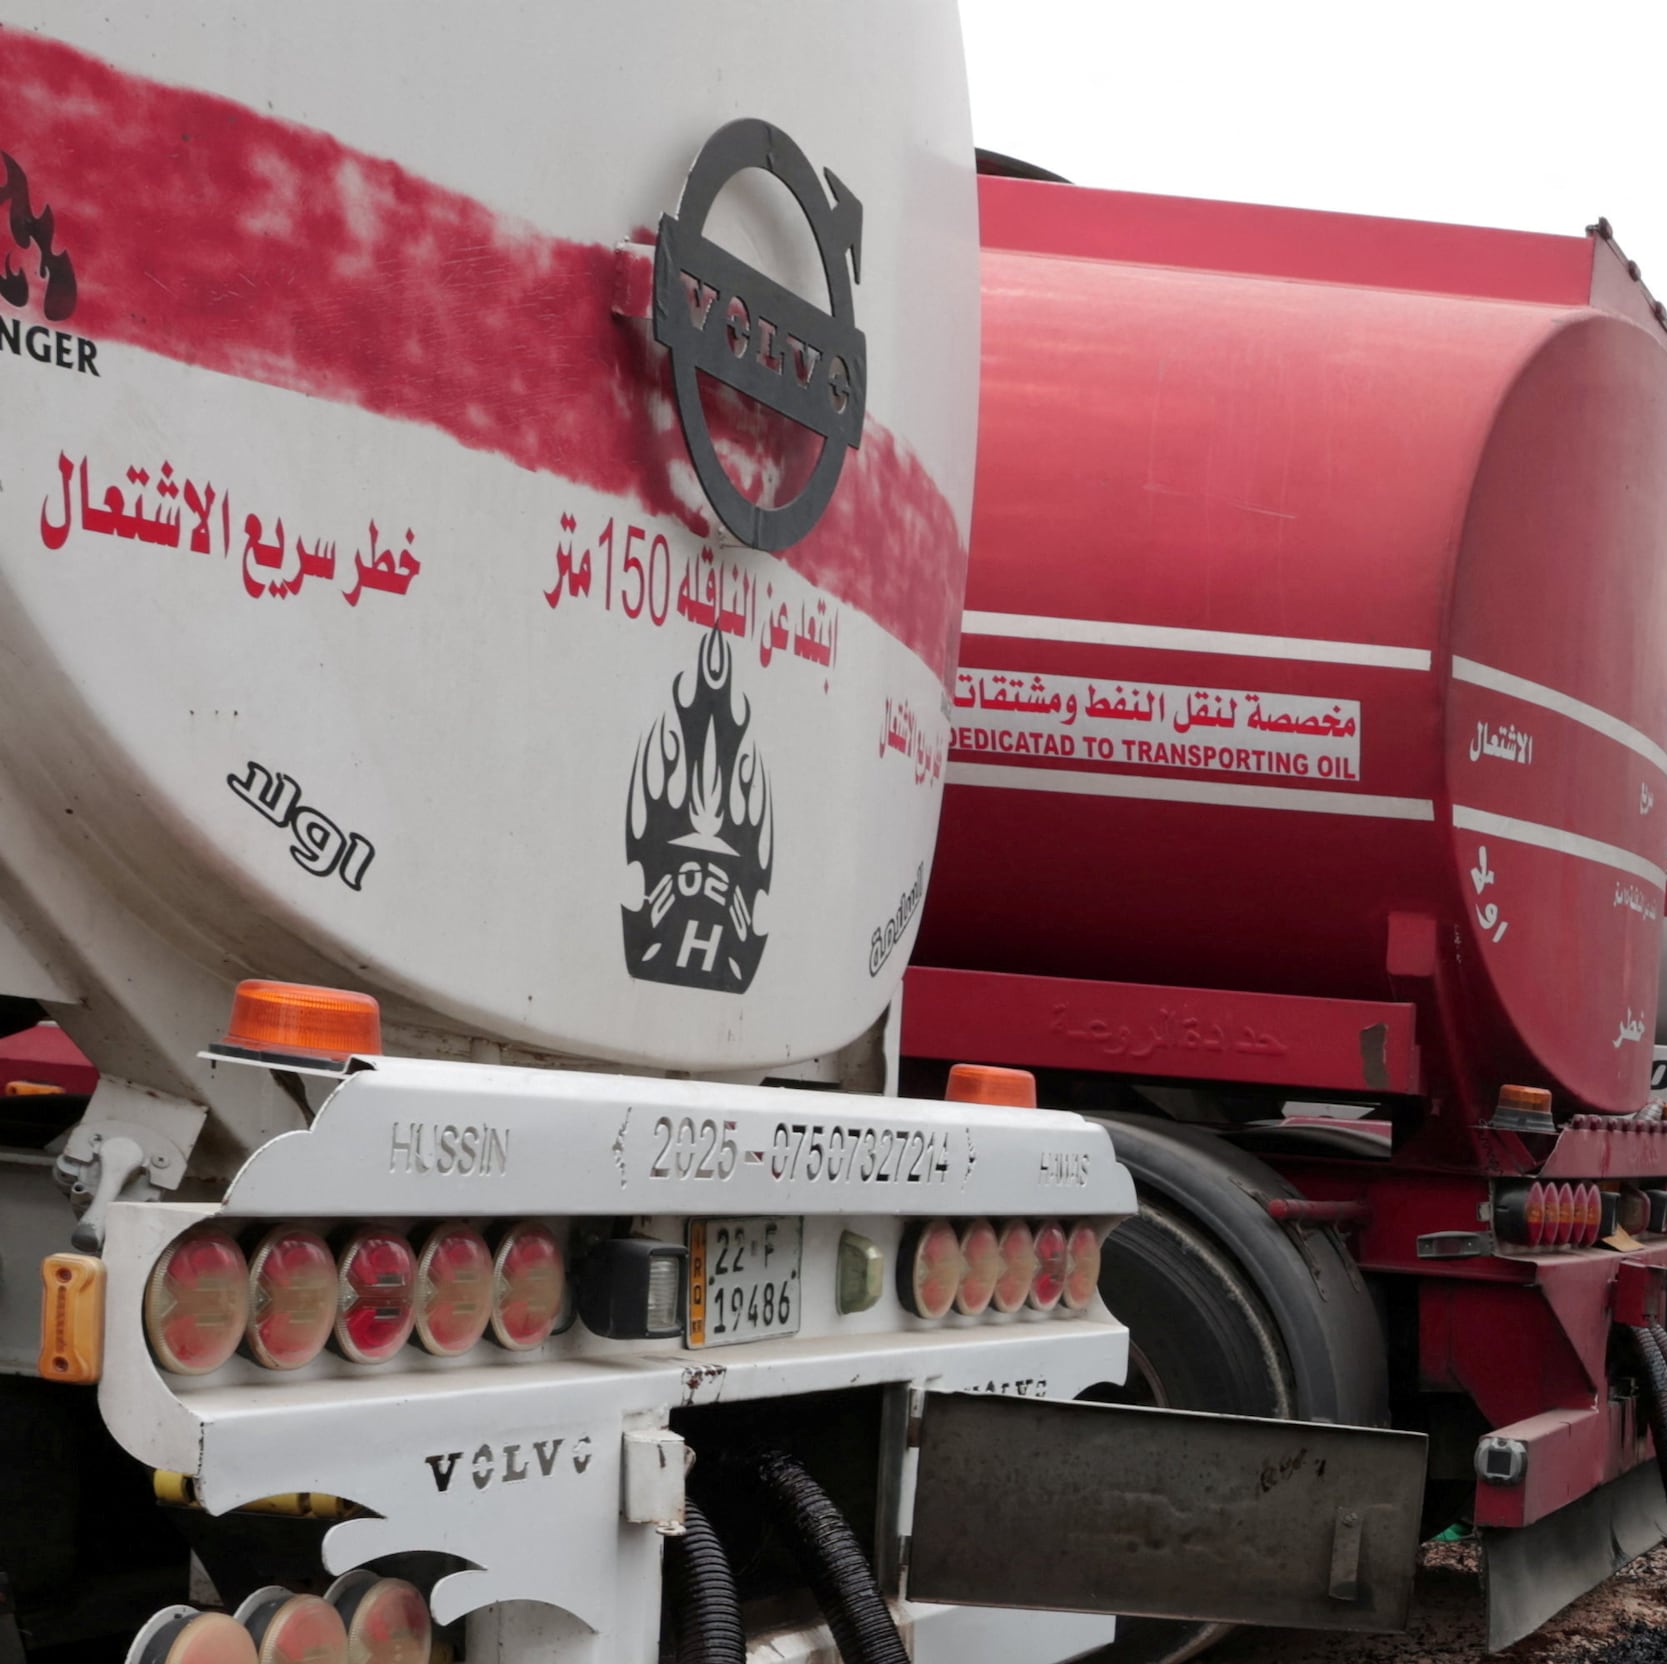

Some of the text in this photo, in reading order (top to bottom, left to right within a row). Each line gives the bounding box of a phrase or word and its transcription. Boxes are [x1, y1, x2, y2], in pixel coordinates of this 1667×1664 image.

[0, 315, 101, 377] NGER
[680, 268, 851, 415] VOLVO
[40, 449, 421, 607] خطر سريع الاشتعال
[543, 511, 592, 610] متر
[598, 517, 670, 627] 150
[952, 674, 1357, 738] مخصصة لنقل النفط ومشتقات
[1082, 736, 1114, 760] TO
[1121, 739, 1309, 777] TRANSPORTING
[1317, 755, 1356, 780] OIL
[1469, 720, 1533, 764] الاشتعال
[675, 919, 724, 972] H
[388, 1121, 511, 1178] HUSSIN
[715, 1227, 745, 1276] 22
[713, 1280, 791, 1335] 19486
[424, 1435, 592, 1493] VOLVO
